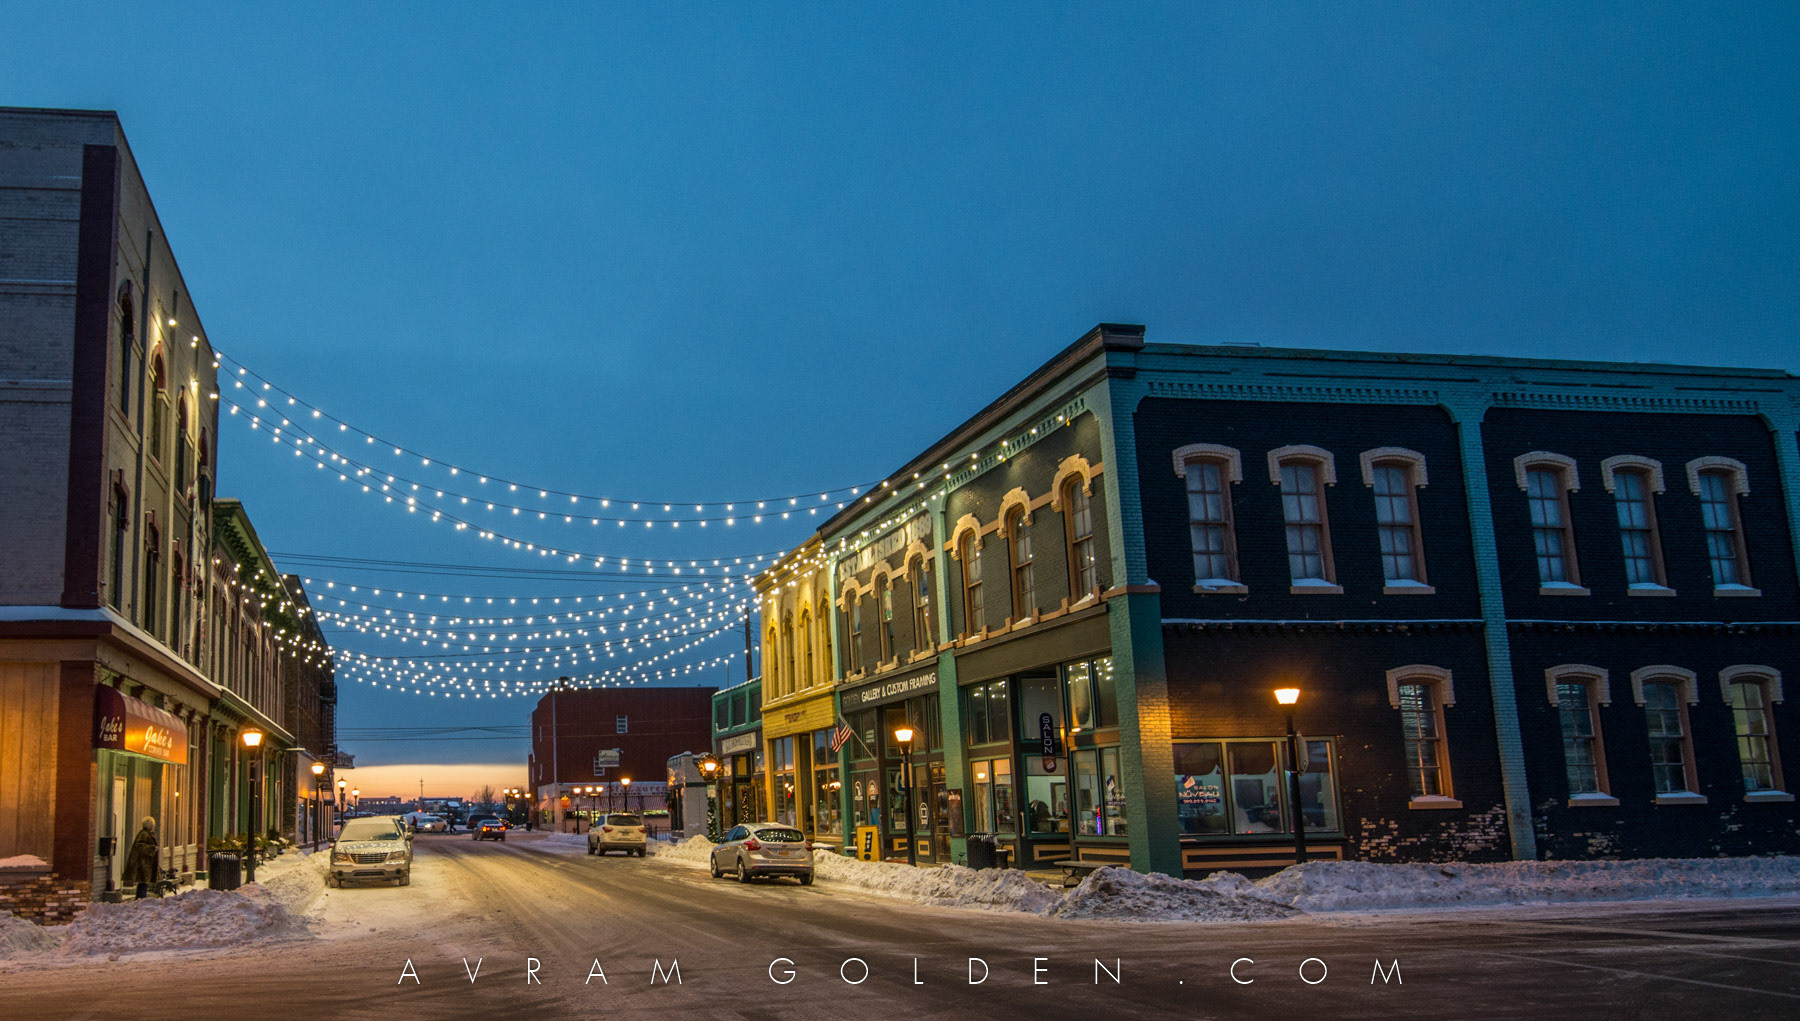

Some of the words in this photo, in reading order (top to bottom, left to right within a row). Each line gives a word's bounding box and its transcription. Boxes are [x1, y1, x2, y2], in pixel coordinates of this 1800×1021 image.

[839, 528, 906, 583] ESTABLISHED
[861, 686, 881, 702] GALLERY
[881, 684, 887, 698] &
[886, 679, 909, 696] CUSTOM
[909, 671, 937, 690] FRAMING
[99, 715, 123, 739] Jake's
[103, 733, 118, 742] BAR
[143, 725, 173, 752] Jake's
[1042, 715, 1053, 754] SALON
